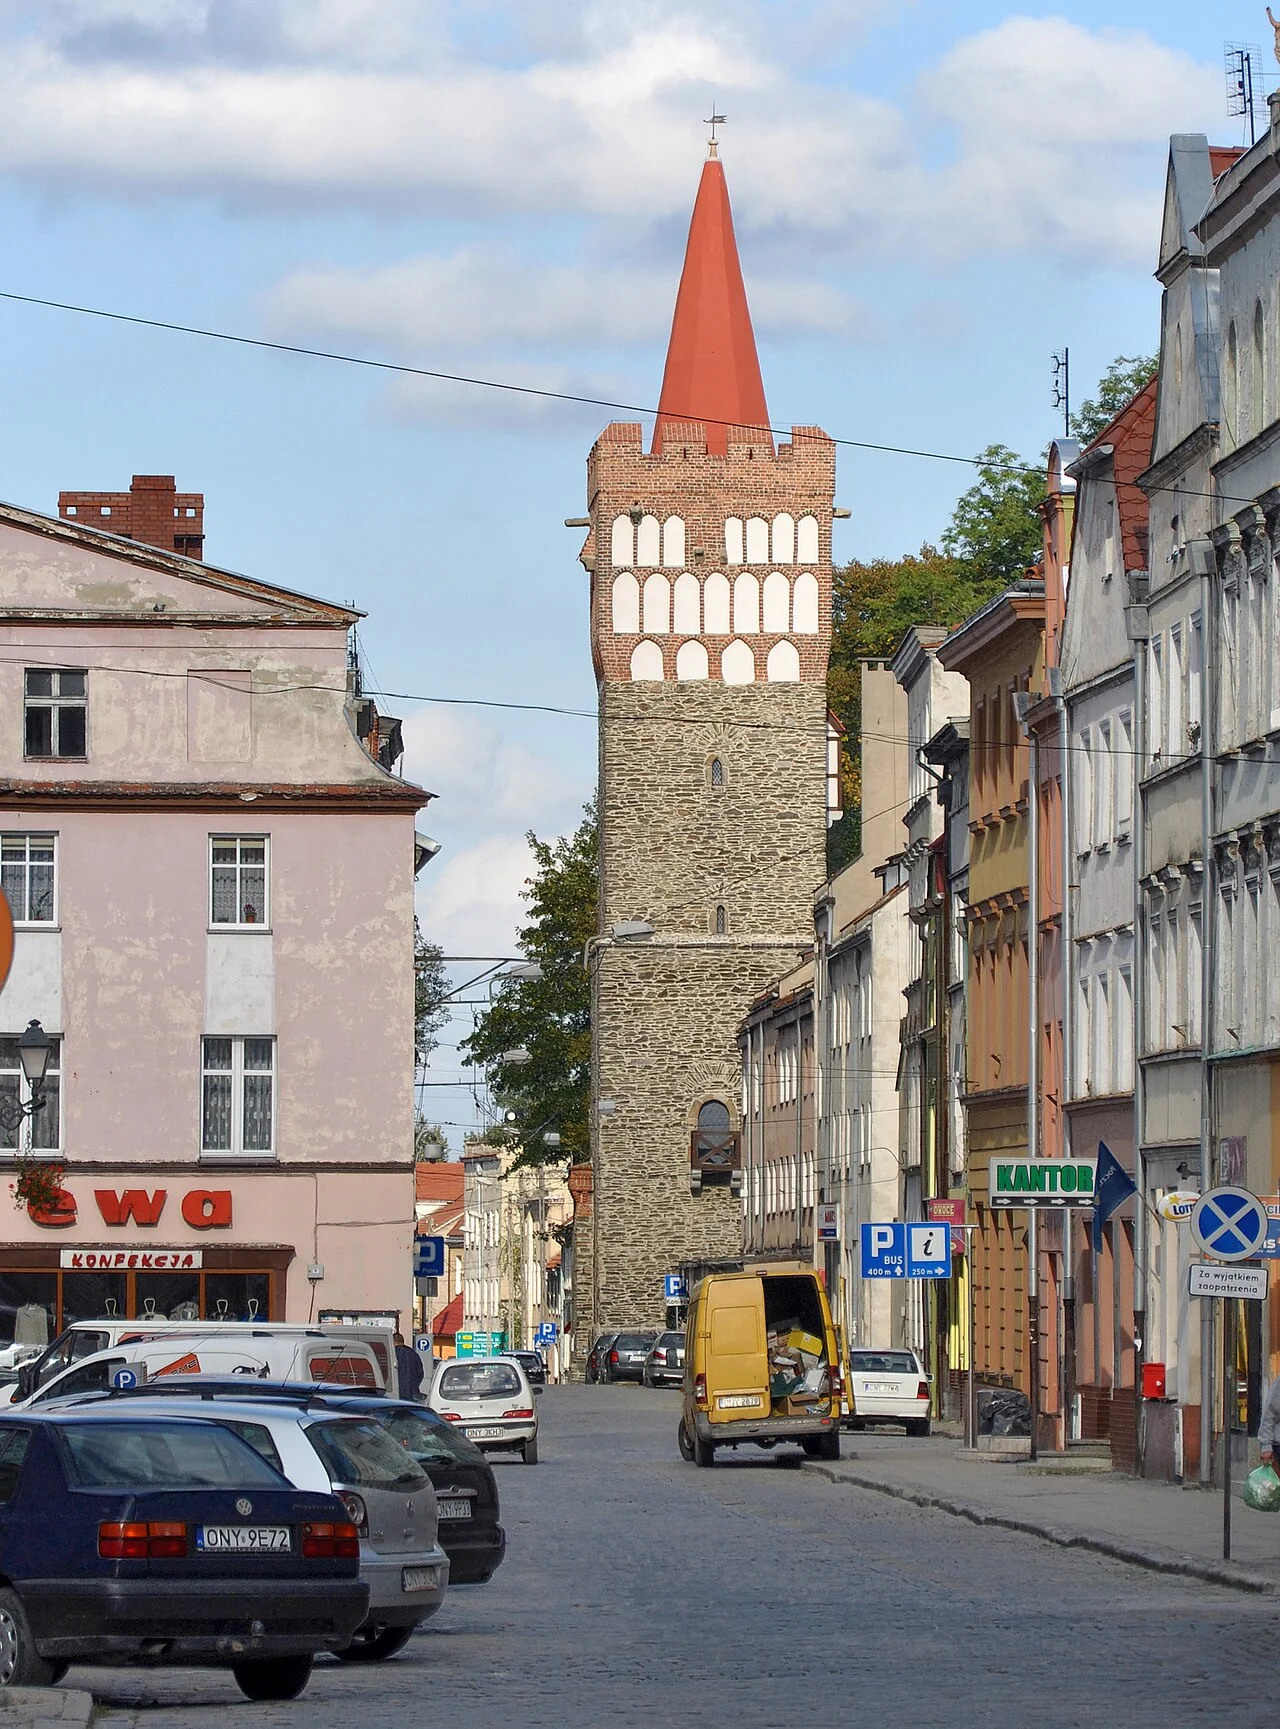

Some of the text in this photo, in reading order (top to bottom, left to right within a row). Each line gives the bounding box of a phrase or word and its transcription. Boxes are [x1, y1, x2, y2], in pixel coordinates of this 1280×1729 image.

[997, 1165, 1094, 1192] KANTOR
[27, 1188, 232, 1228] ewa
[1173, 1203, 1194, 1215] LOTT
[871, 1226, 894, 1257] P
[72, 1253, 194, 1268] KONFEKCJA
[414, 1241, 436, 1271] P
[884, 1256, 903, 1265] BUS
[868, 1268, 883, 1276] 400
[912, 1268, 925, 1276] 250
[1199, 1270, 1210, 1278] Za
[669, 1277, 682, 1294] P
[1198, 1283, 1258, 1293] zaopatrzenia
[542, 1324, 552, 1336] P
[119, 1372, 132, 1388] P
[206, 1529, 241, 1547] ONY
[248, 1529, 288, 1547] 9E72
